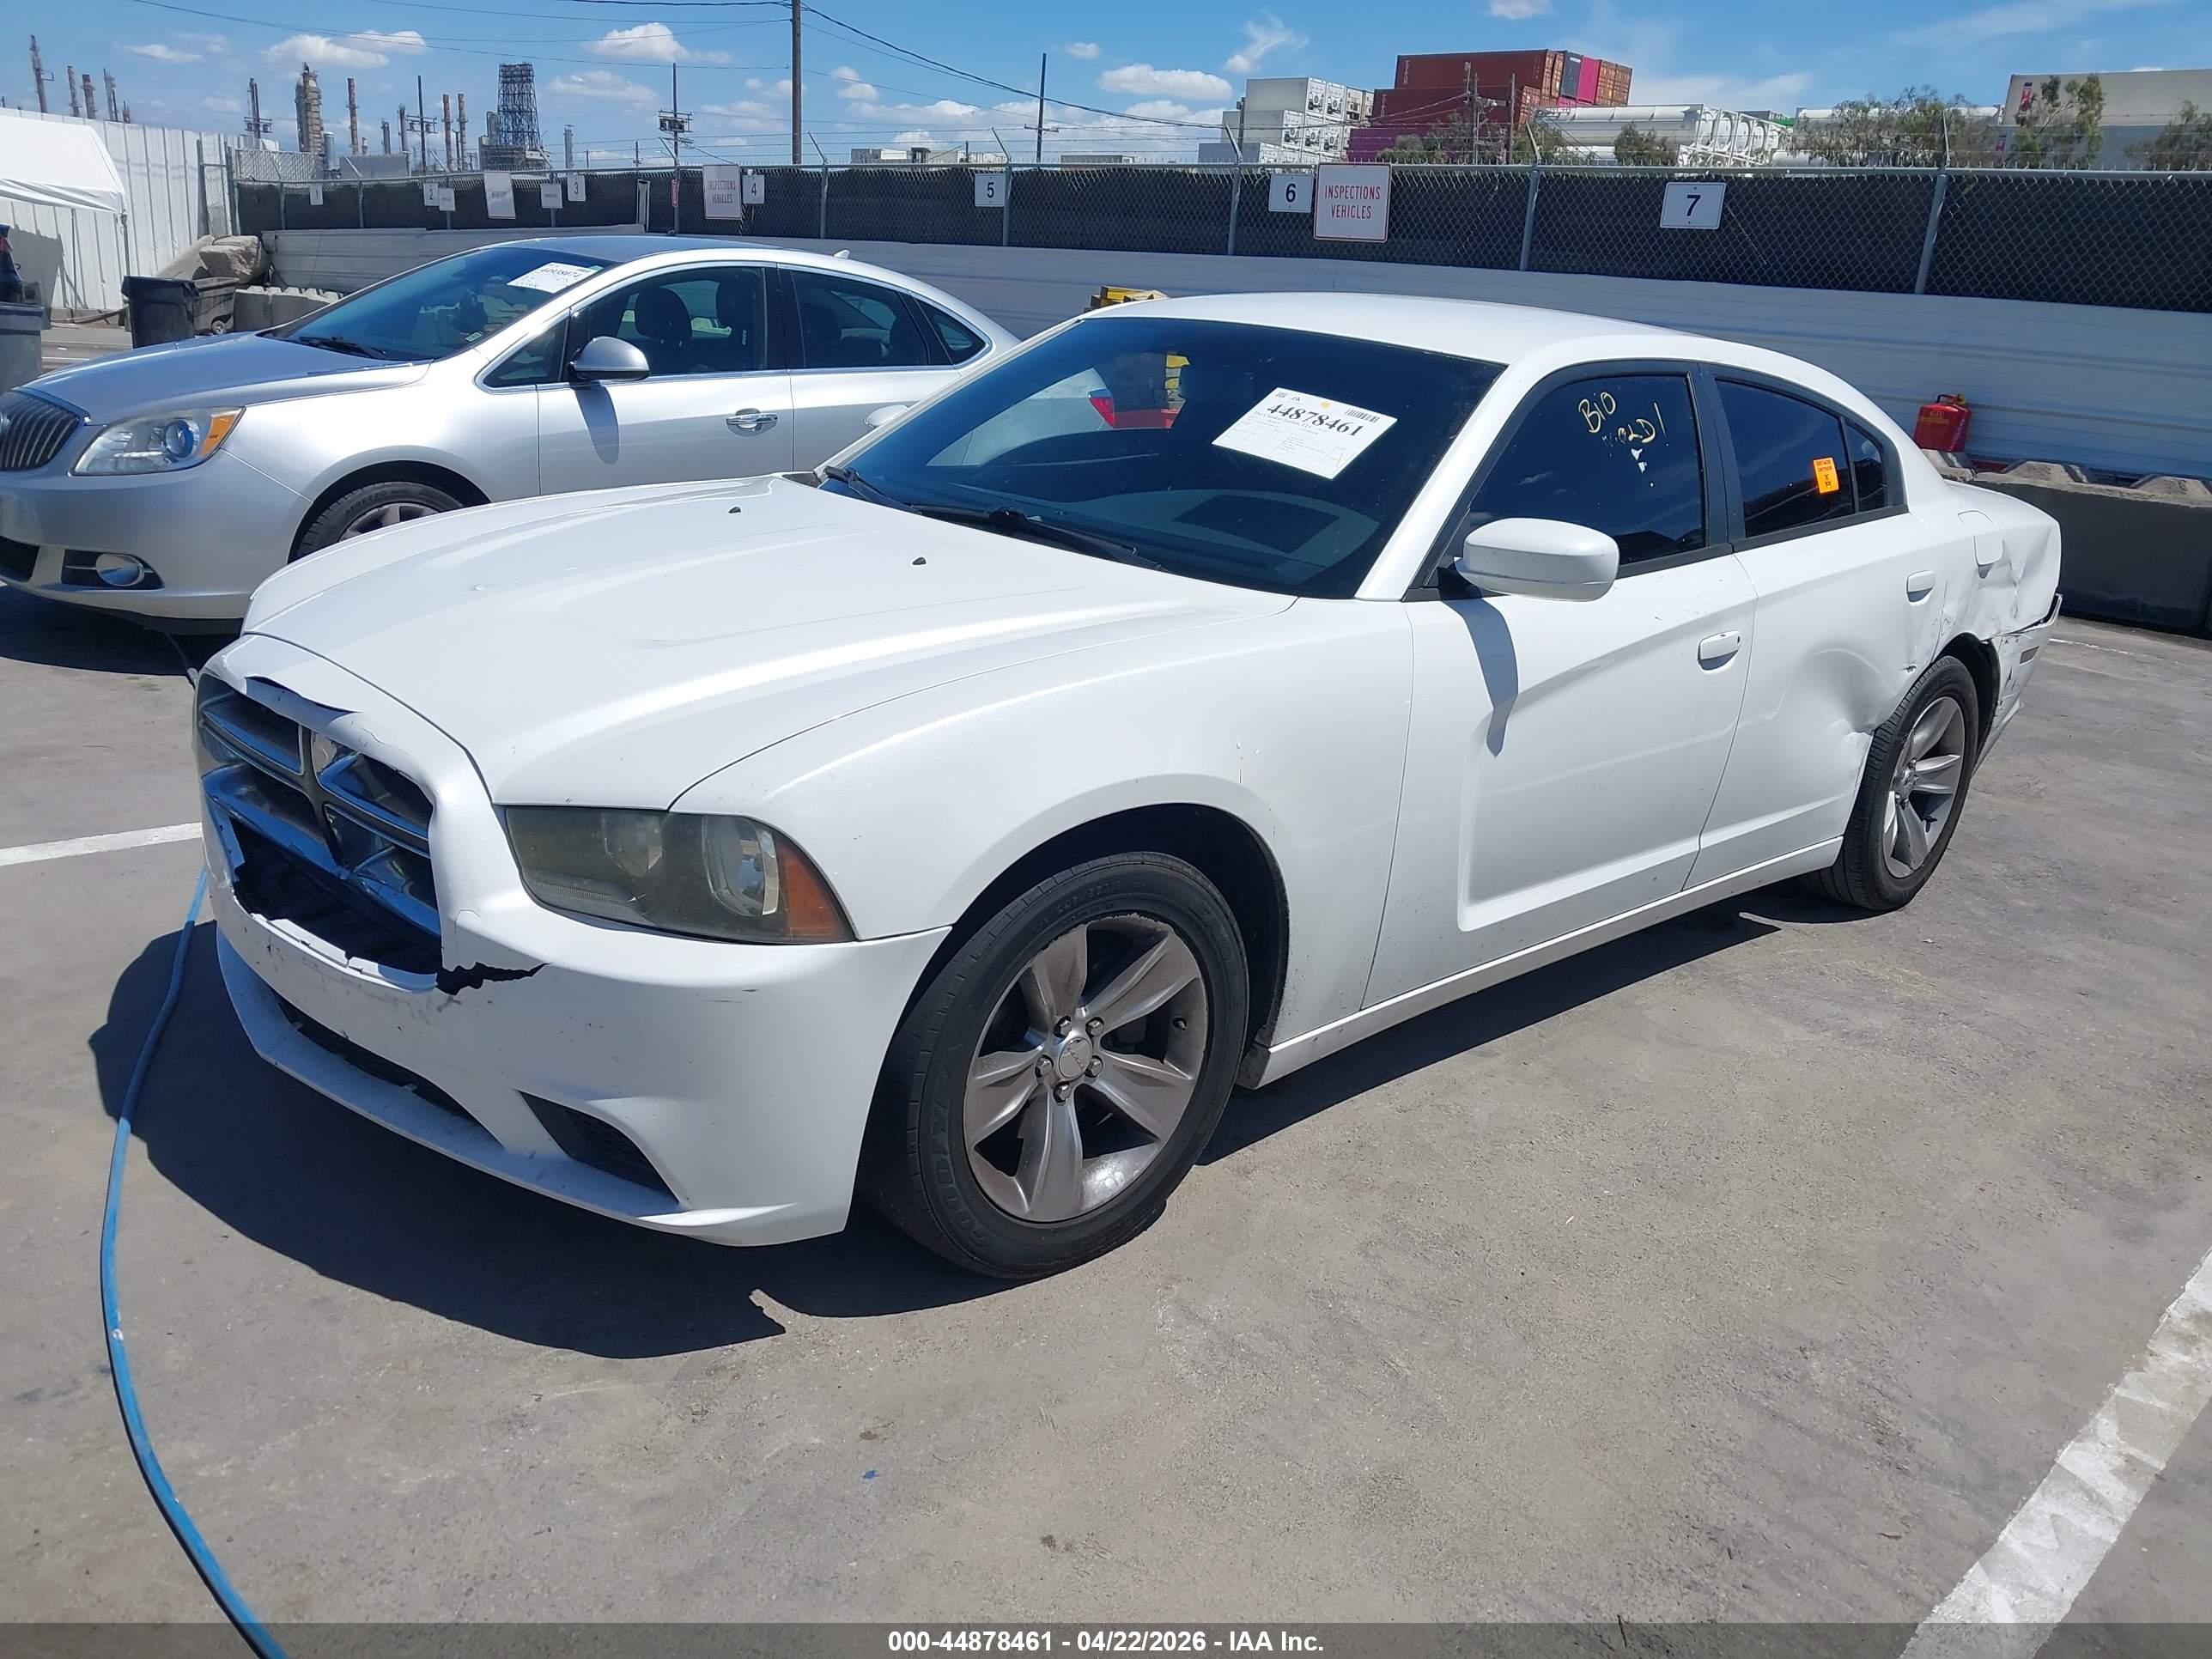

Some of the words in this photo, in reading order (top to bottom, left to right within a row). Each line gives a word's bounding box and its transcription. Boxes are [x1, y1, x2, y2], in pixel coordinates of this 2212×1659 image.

[429, 188, 434, 200] 2
[574, 182, 579, 195] 3
[751, 182, 757, 197] 4
[987, 181, 994, 198] 5
[1285, 183, 1297, 203] 6
[1324, 185, 1381, 200] INSPECTIONS
[712, 193, 733, 204] VEHICLES
[1686, 194, 1701, 216] 7
[1331, 204, 1371, 219] VEHICLES
[1267, 404, 1364, 436] 44878461
